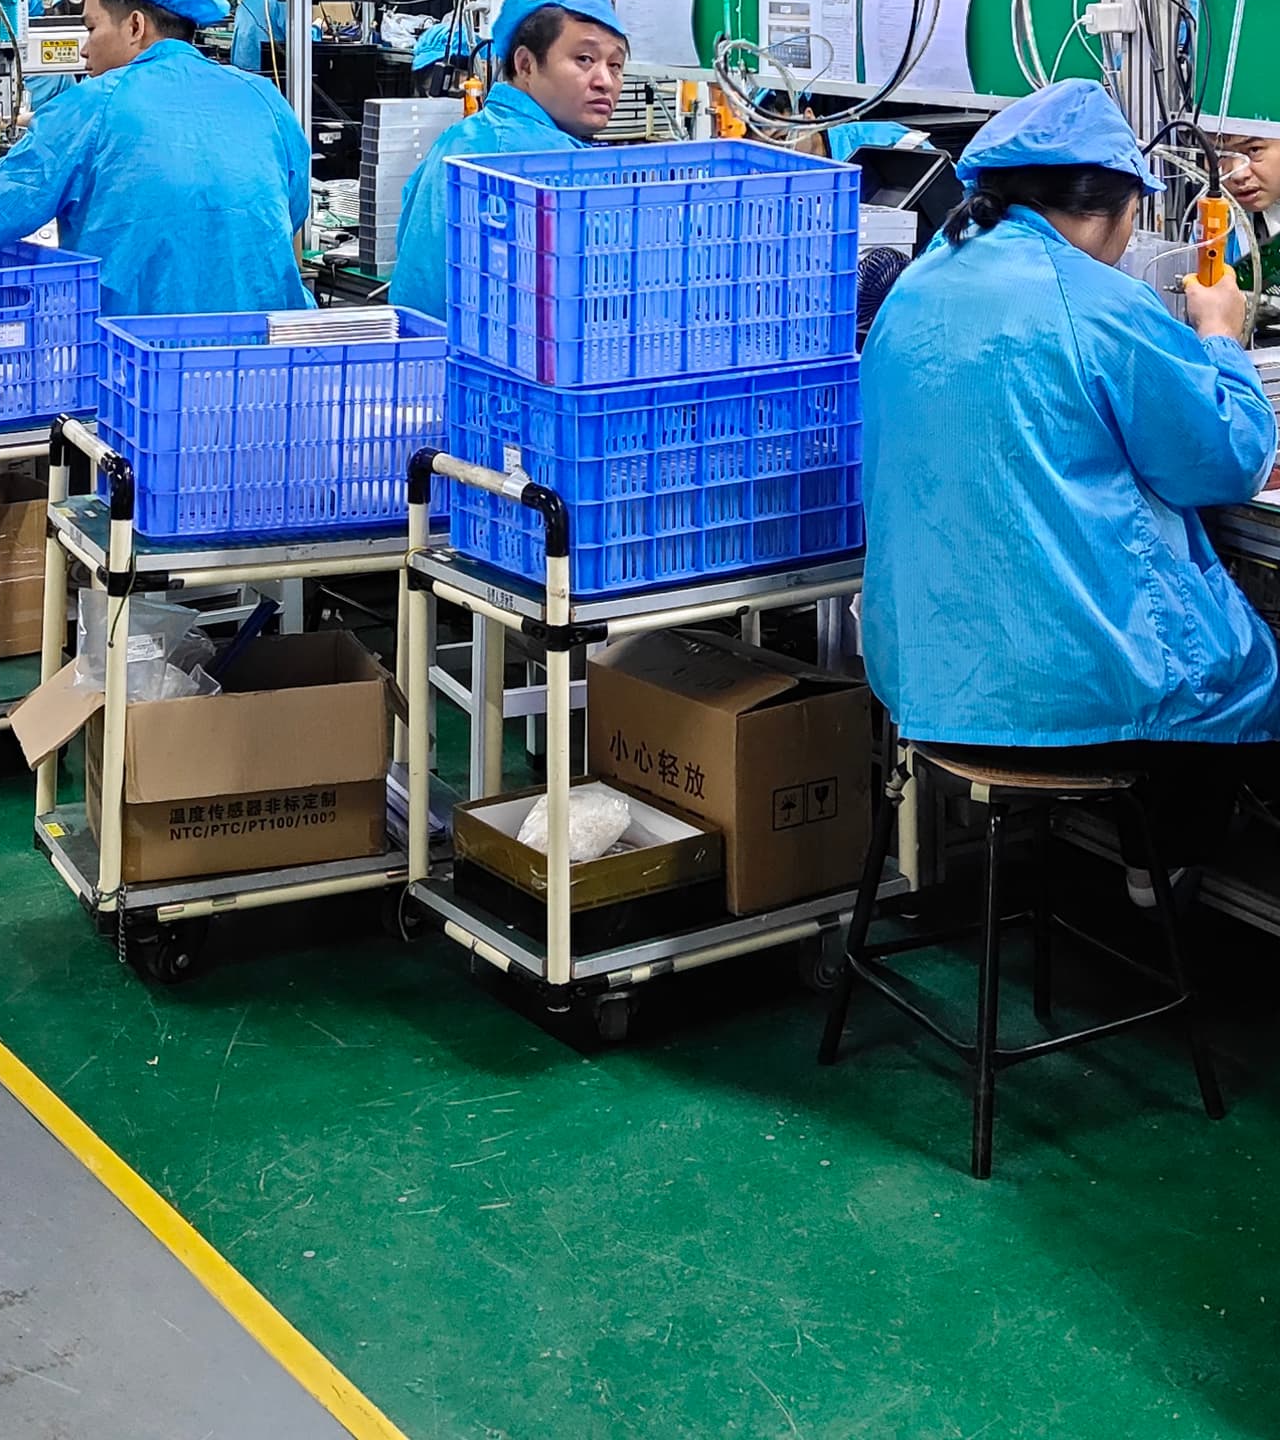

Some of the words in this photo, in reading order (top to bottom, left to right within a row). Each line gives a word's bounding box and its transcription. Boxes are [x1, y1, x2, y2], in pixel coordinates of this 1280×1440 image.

[609, 729, 705, 800] 小心轻放
[169, 790, 337, 824] 温度传感器非标定制
